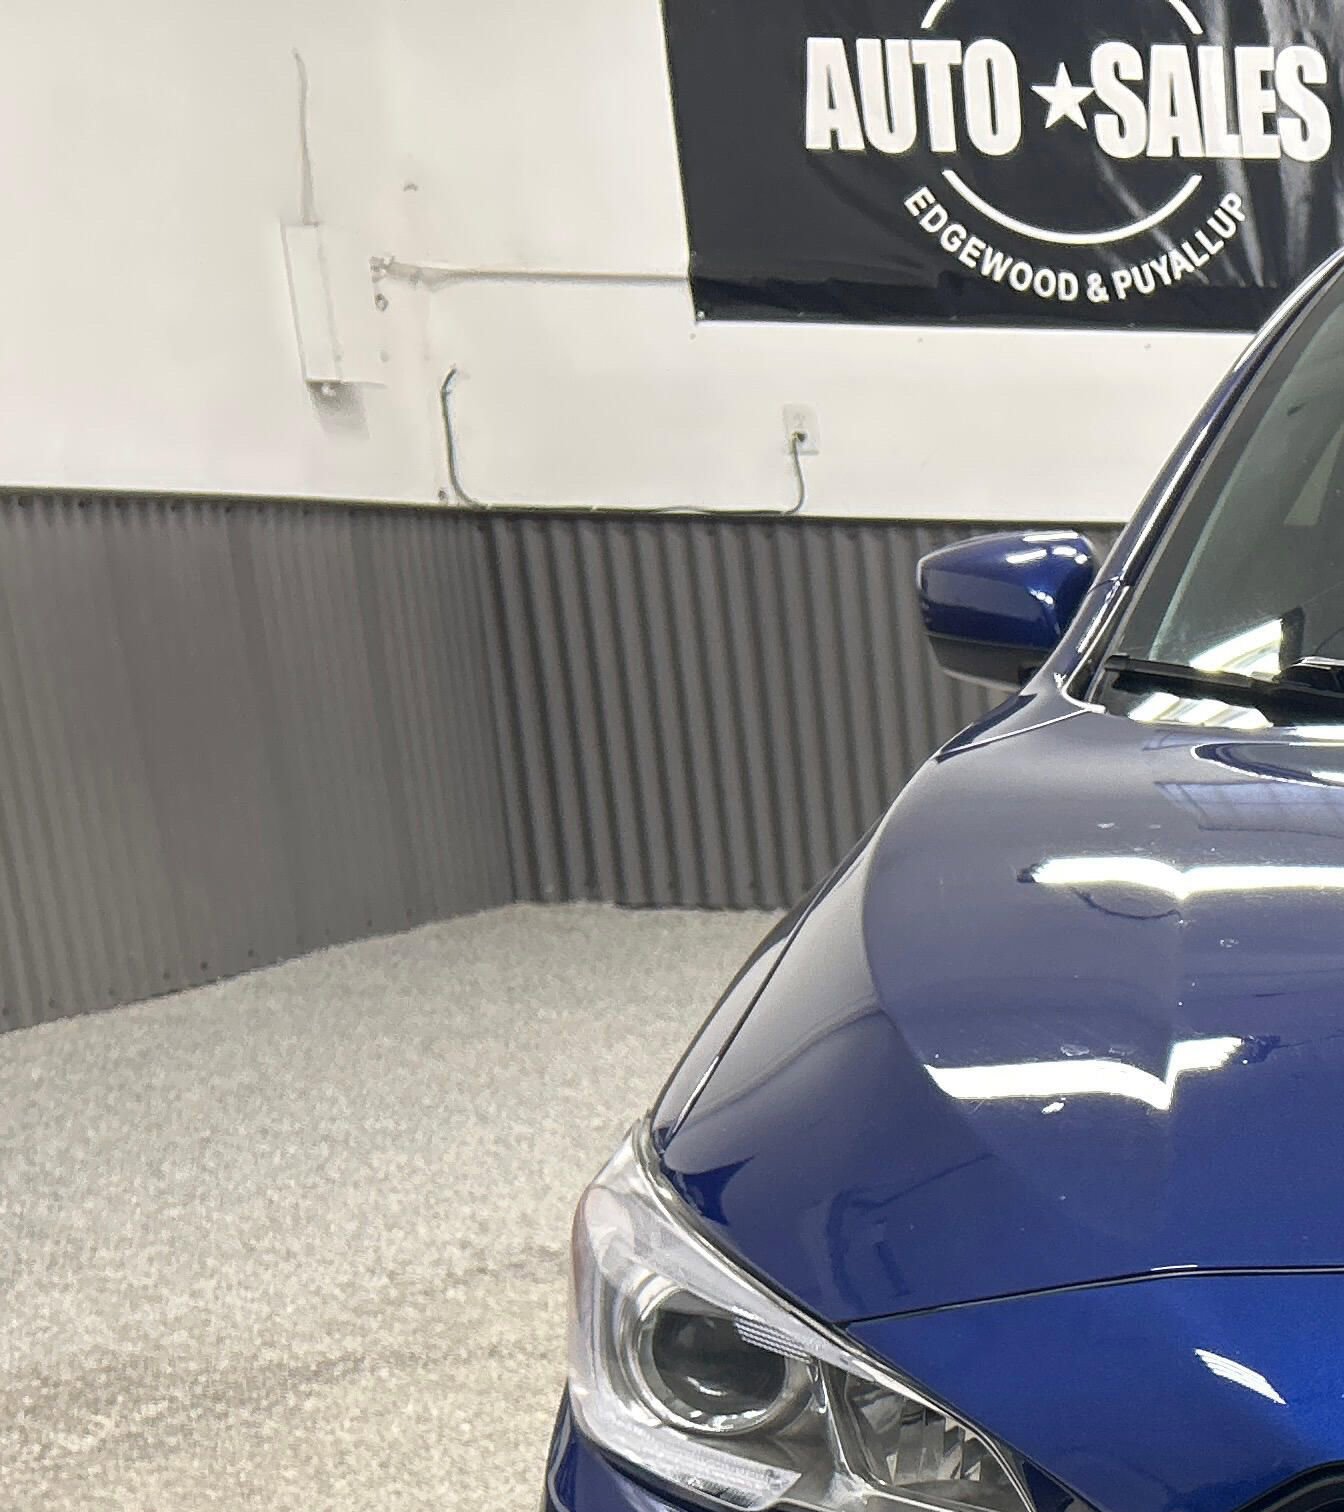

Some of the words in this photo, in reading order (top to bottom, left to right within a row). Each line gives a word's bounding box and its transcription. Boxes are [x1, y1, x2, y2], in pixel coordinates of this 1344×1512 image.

[805, 38, 1021, 156] AUTO
[1091, 41, 1332, 163] SALES
[903, 186, 1078, 302] EDGEWOOD
[1087, 278, 1109, 304] &
[1114, 193, 1247, 301] PUYALLUP
